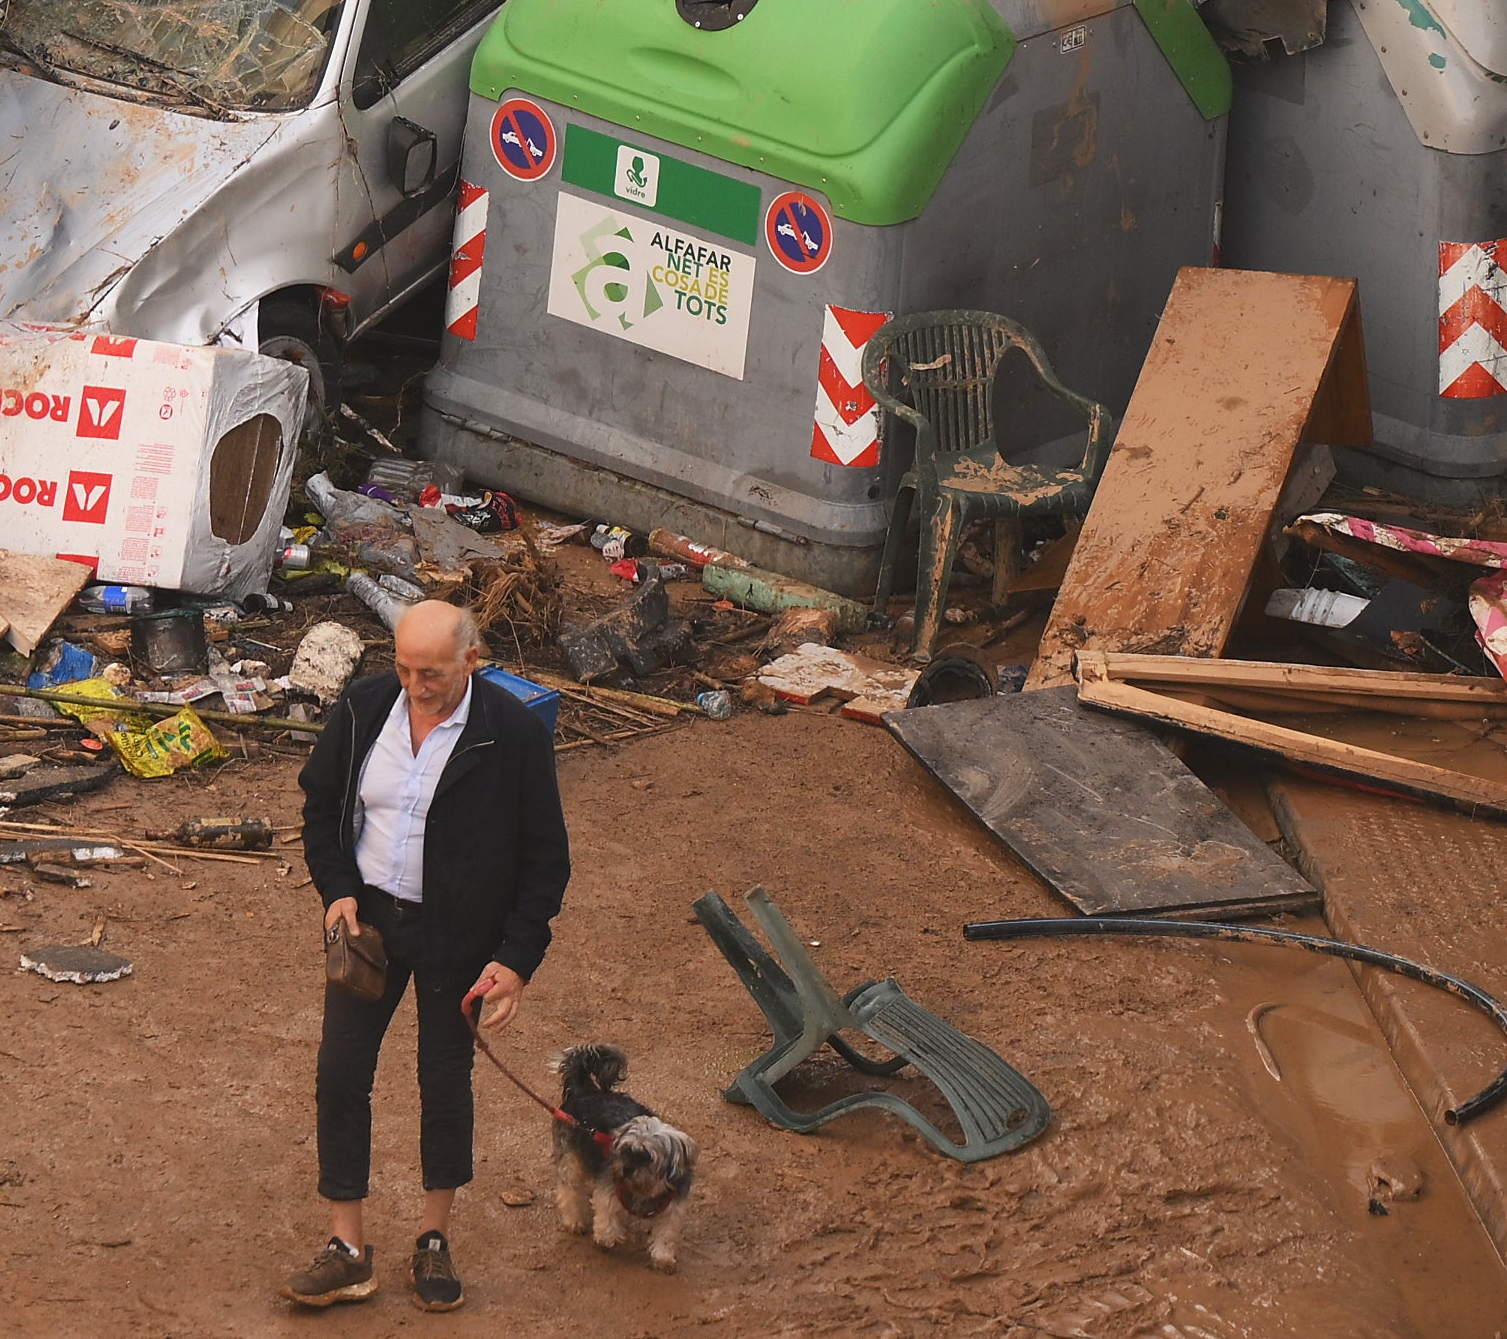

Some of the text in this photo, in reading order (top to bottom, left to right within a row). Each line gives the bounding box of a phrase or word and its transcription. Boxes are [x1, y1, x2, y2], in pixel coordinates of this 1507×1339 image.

[625, 185, 646, 199] vidre
[650, 231, 732, 273] ALFAFAR
[667, 252, 730, 288] NET ES
[651, 265, 729, 306] COSA DE
[674, 290, 728, 325] TOTS
